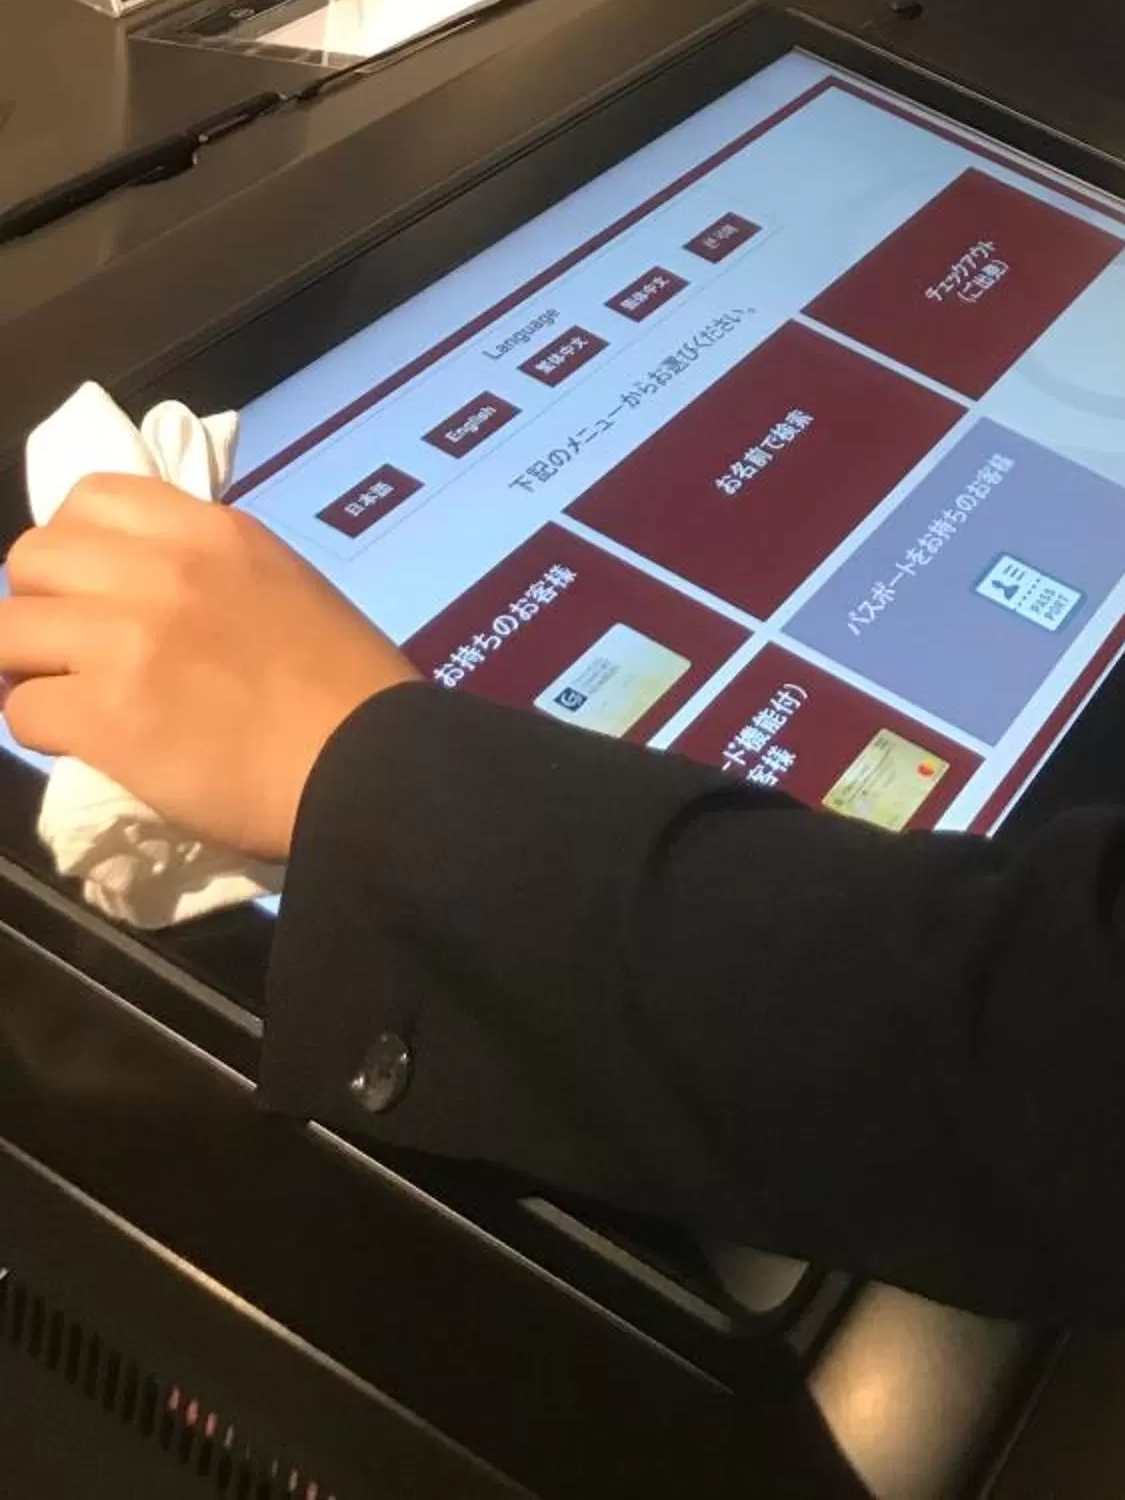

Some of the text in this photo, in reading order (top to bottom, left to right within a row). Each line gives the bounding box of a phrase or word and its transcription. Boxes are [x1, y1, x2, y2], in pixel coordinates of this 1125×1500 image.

[924, 240, 998, 302] チェックアウト
[482, 307, 561, 361] Language
[444, 404, 497, 445] English
[714, 408, 815, 497] お名前で検索
[345, 481, 395, 518] 日本語
[847, 452, 1015, 636] パスポートをお持ちのお客様
[432, 563, 578, 689] お持ちのお客様
